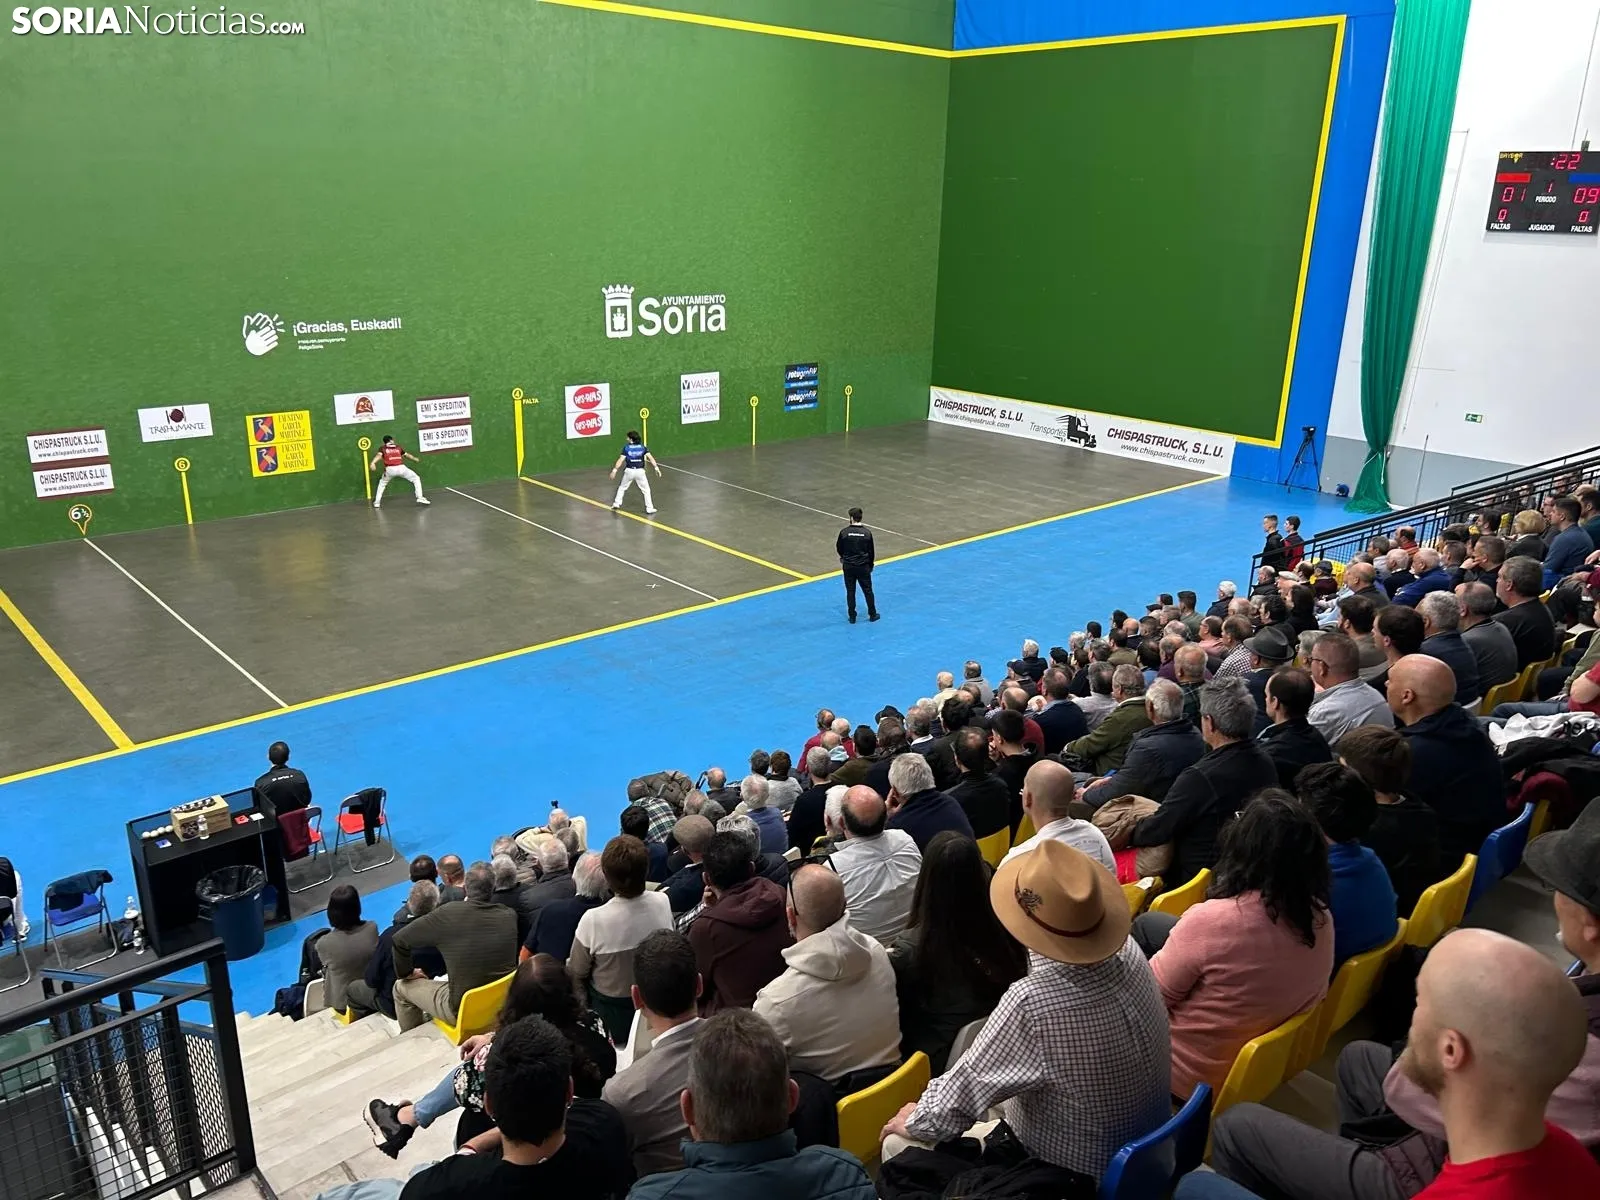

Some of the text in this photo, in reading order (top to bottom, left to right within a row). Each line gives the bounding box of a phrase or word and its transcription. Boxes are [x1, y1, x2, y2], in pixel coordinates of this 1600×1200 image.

[1573, 187, 1600, 204] 09
[1578, 210, 1590, 223] 0
[661, 294, 726, 306] AYUNTAMIENTO
[637, 296, 727, 337] Soria
[292, 317, 402, 337] ¡Gracias, Euskadi!
[691, 379, 718, 389] VALSAY
[438, 400, 467, 411] SPEDITION
[691, 403, 718, 413] VALSAY
[934, 398, 1024, 423] CHISPASTRUCK, S.L.U.
[149, 422, 206, 435] TRASHUMANTE
[944, 411, 1010, 429] www.chispastruck.com
[440, 429, 469, 439] SPEDITION
[1029, 421, 1067, 438] Transportes
[33, 433, 103, 450] CHISPASTRUCK S.L.U.
[1106, 427, 1224, 459] CHISPASTRUCK, S.L.U.
[37, 446, 99, 458] www.chispastruck.com
[1120, 443, 1205, 465] www.chispastruck.com
[39, 468, 108, 485] CHISPASTRUCK S.L.U.
[43, 481, 105, 492] www.chispastruck.com
